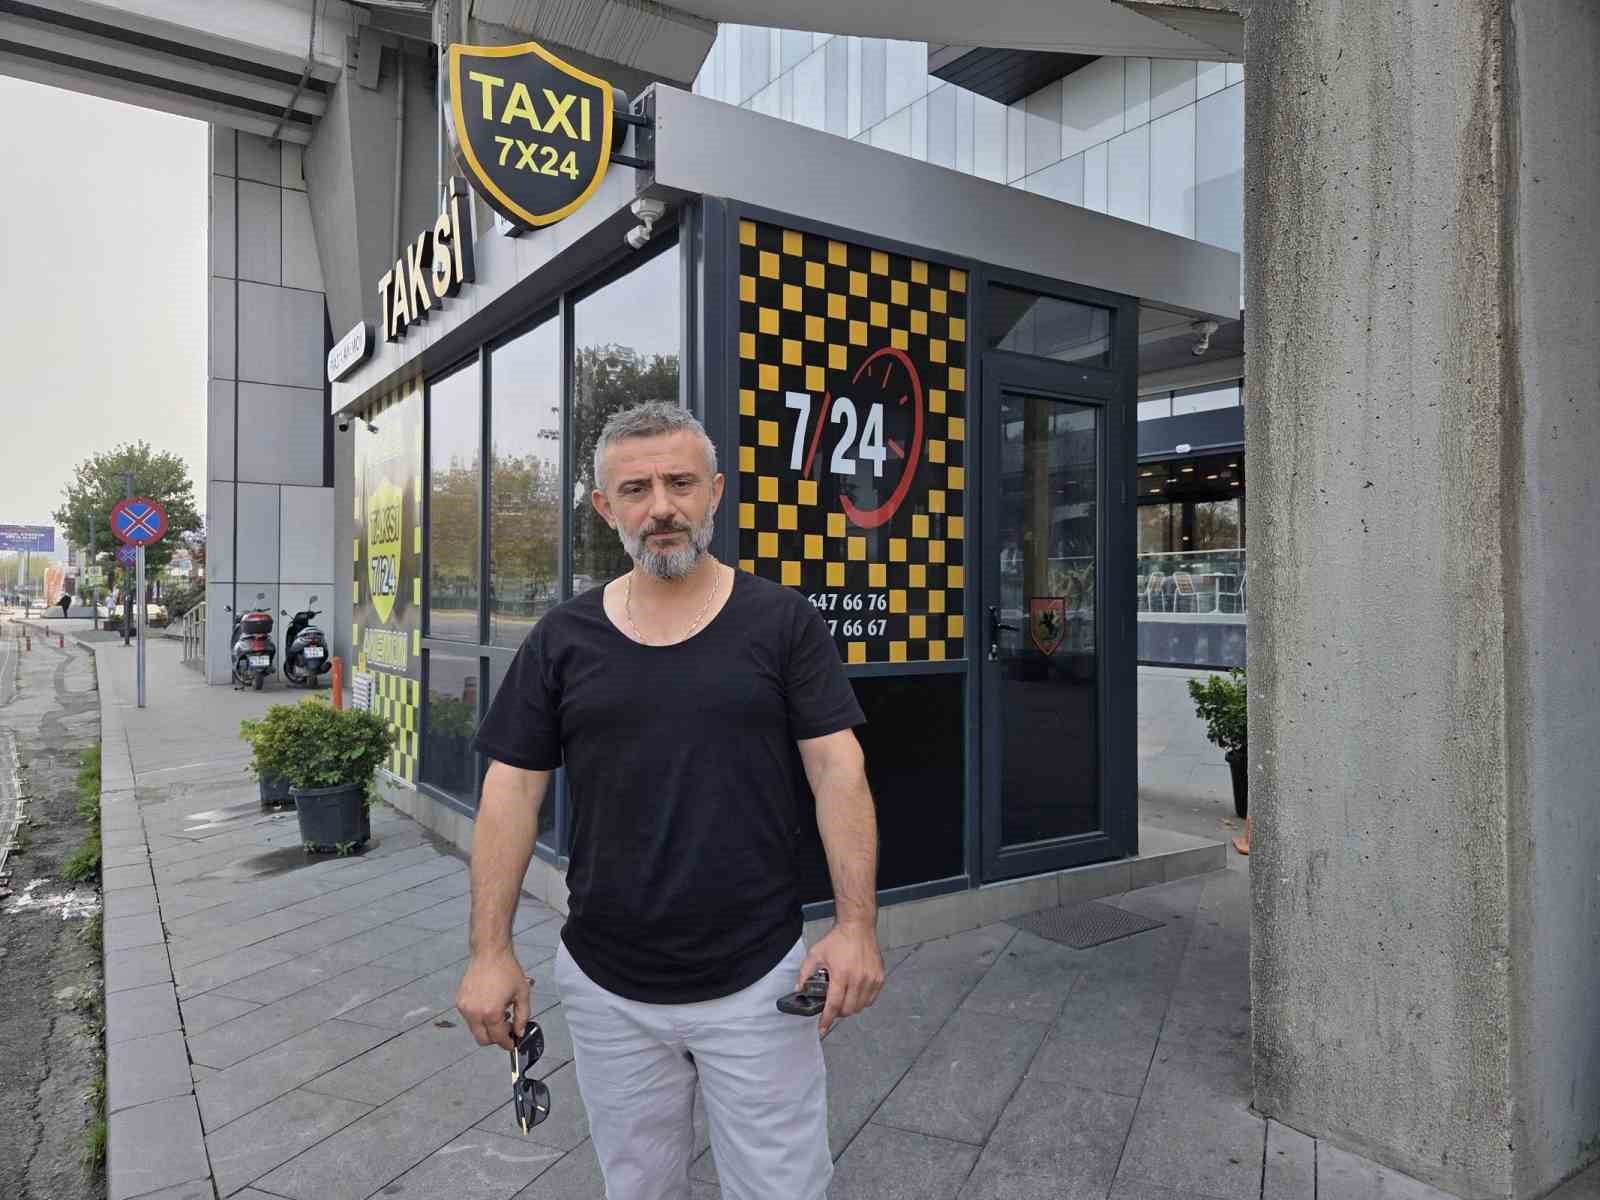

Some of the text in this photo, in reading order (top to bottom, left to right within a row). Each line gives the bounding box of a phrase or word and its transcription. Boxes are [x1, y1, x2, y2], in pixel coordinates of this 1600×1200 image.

[468, 70, 592, 142] TAXI
[494, 135, 580, 181] 7X24
[784, 390, 888, 479] 7/24
[842, 593, 863, 611] 66
[867, 593, 887, 611] 76
[842, 619, 863, 637] 66
[867, 619, 888, 636] 67
